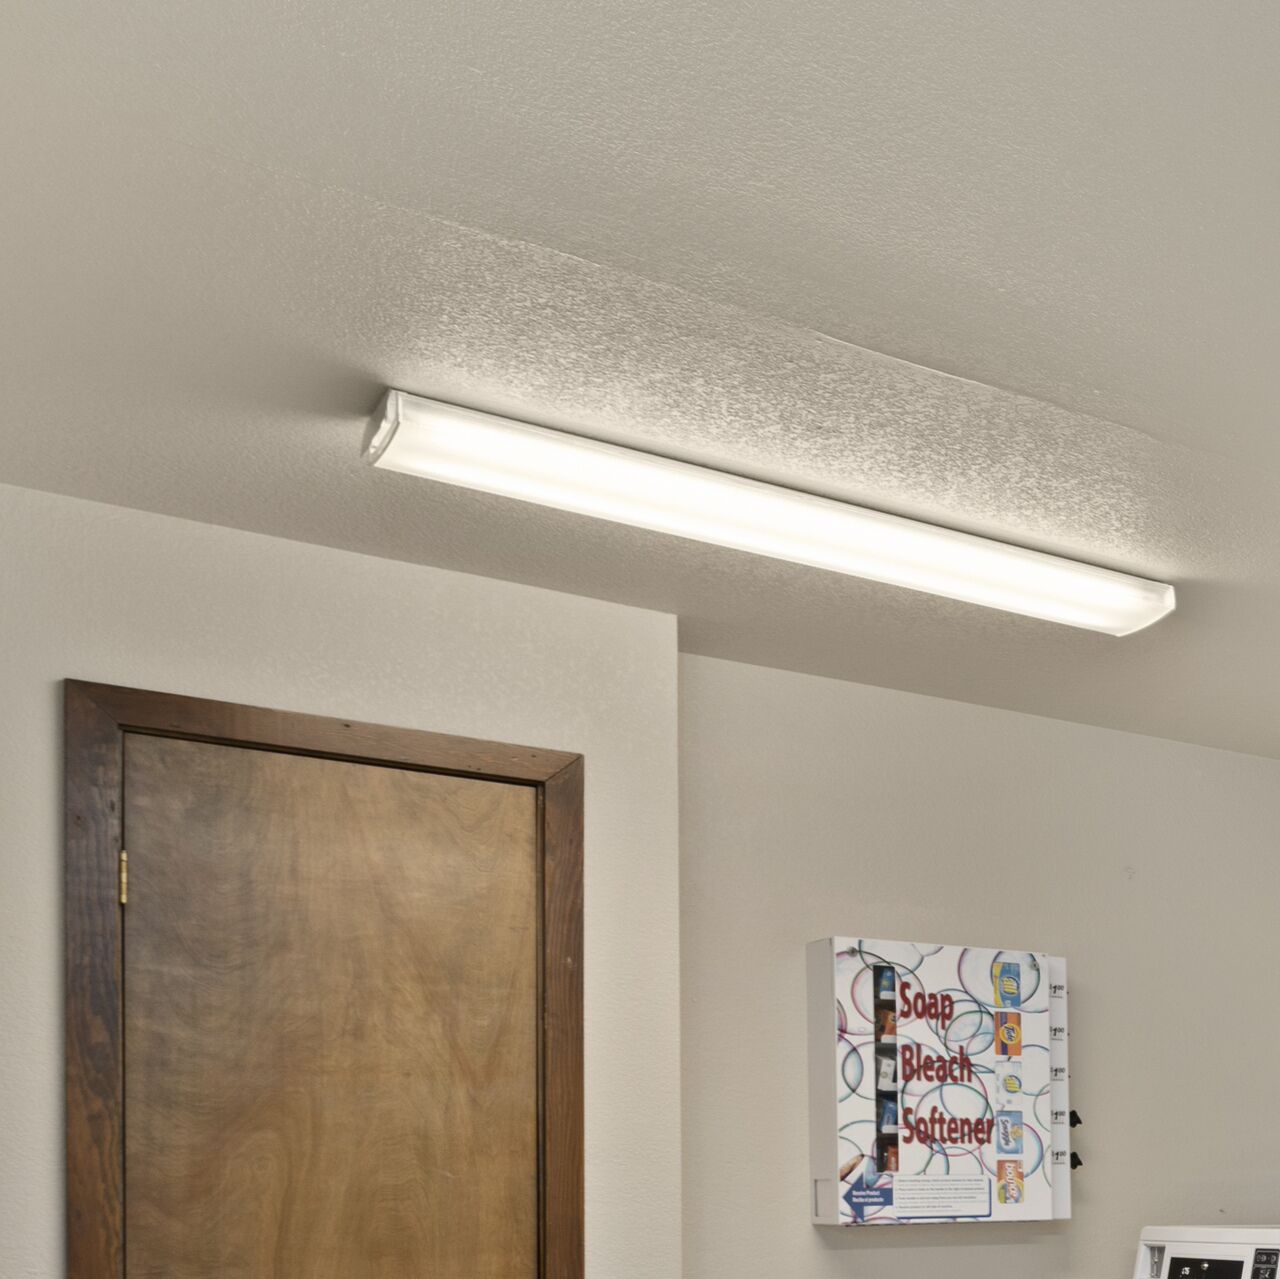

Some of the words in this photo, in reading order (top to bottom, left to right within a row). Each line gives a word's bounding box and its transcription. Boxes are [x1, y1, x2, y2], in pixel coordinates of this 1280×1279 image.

[900, 981, 954, 1029] Soap
[901, 1043, 973, 1083] Bleach
[903, 1106, 995, 1144] Softener
